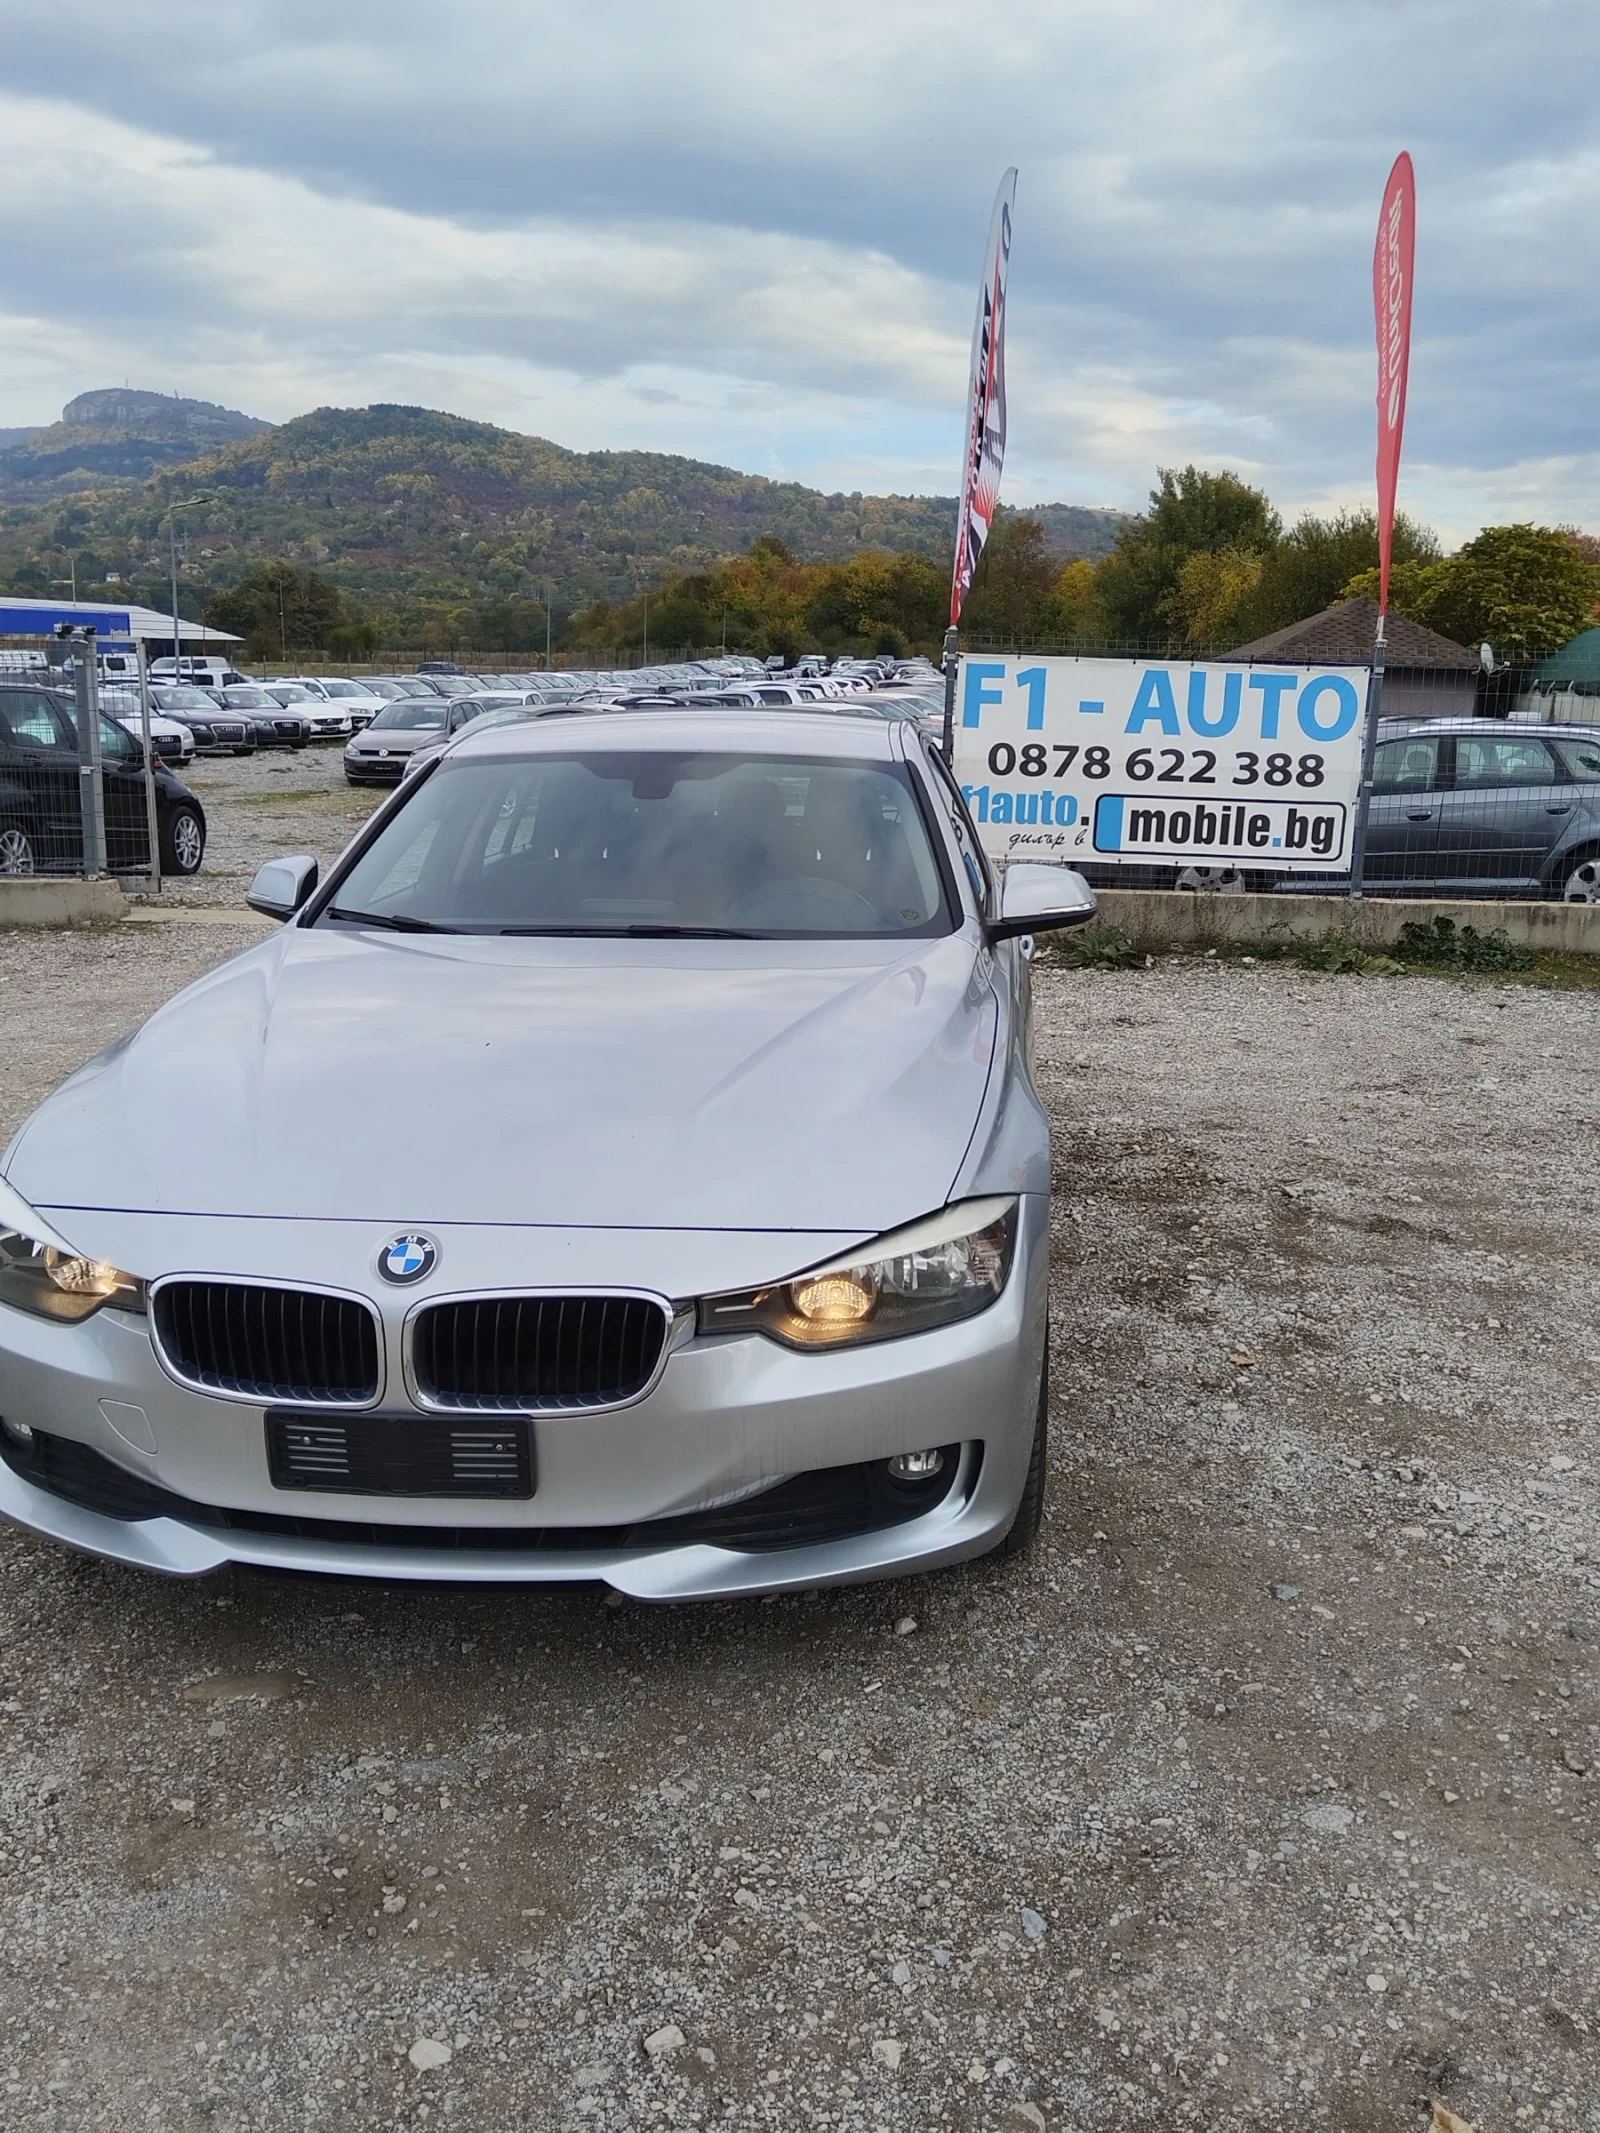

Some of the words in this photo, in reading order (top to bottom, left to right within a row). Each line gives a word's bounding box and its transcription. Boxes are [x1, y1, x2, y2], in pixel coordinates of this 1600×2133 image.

[963, 663, 1047, 730] F1
[1080, 700, 1104, 713] -
[1125, 669, 1359, 742] AUTO
[988, 743, 1111, 779] 0878
[1125, 748, 1217, 783] 622
[1232, 751, 1325, 787] 388
[1009, 832, 1066, 850] дилър
[1128, 805, 1335, 854] mobile.bg
[386, 1235, 434, 1252] BMW
